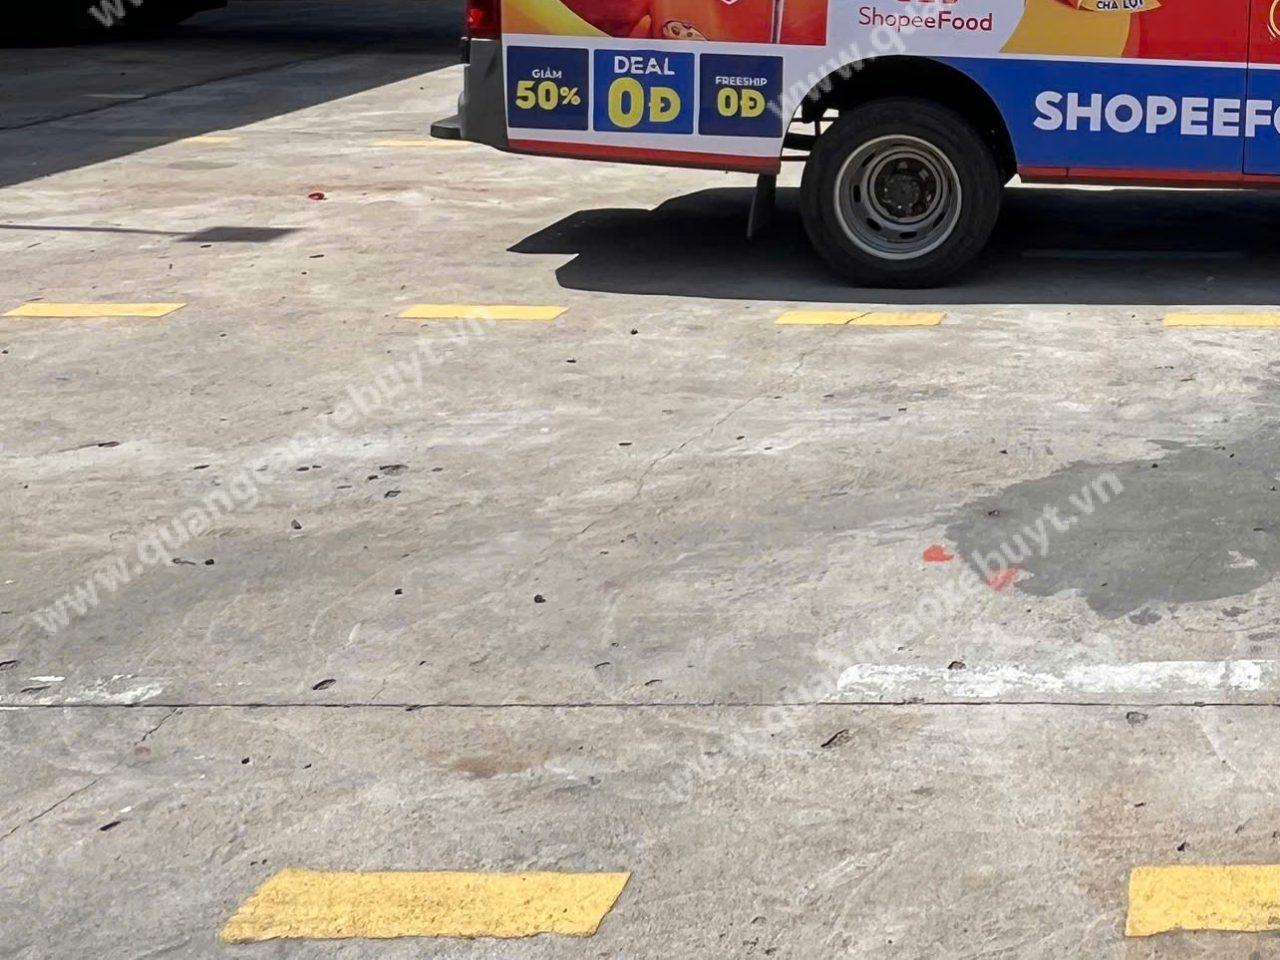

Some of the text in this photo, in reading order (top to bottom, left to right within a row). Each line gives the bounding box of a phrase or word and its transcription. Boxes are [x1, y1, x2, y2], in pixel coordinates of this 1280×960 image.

[858, 6, 993, 33] ShopeeFood
[614, 55, 675, 76] DEAL
[515, 80, 581, 110] 50%
